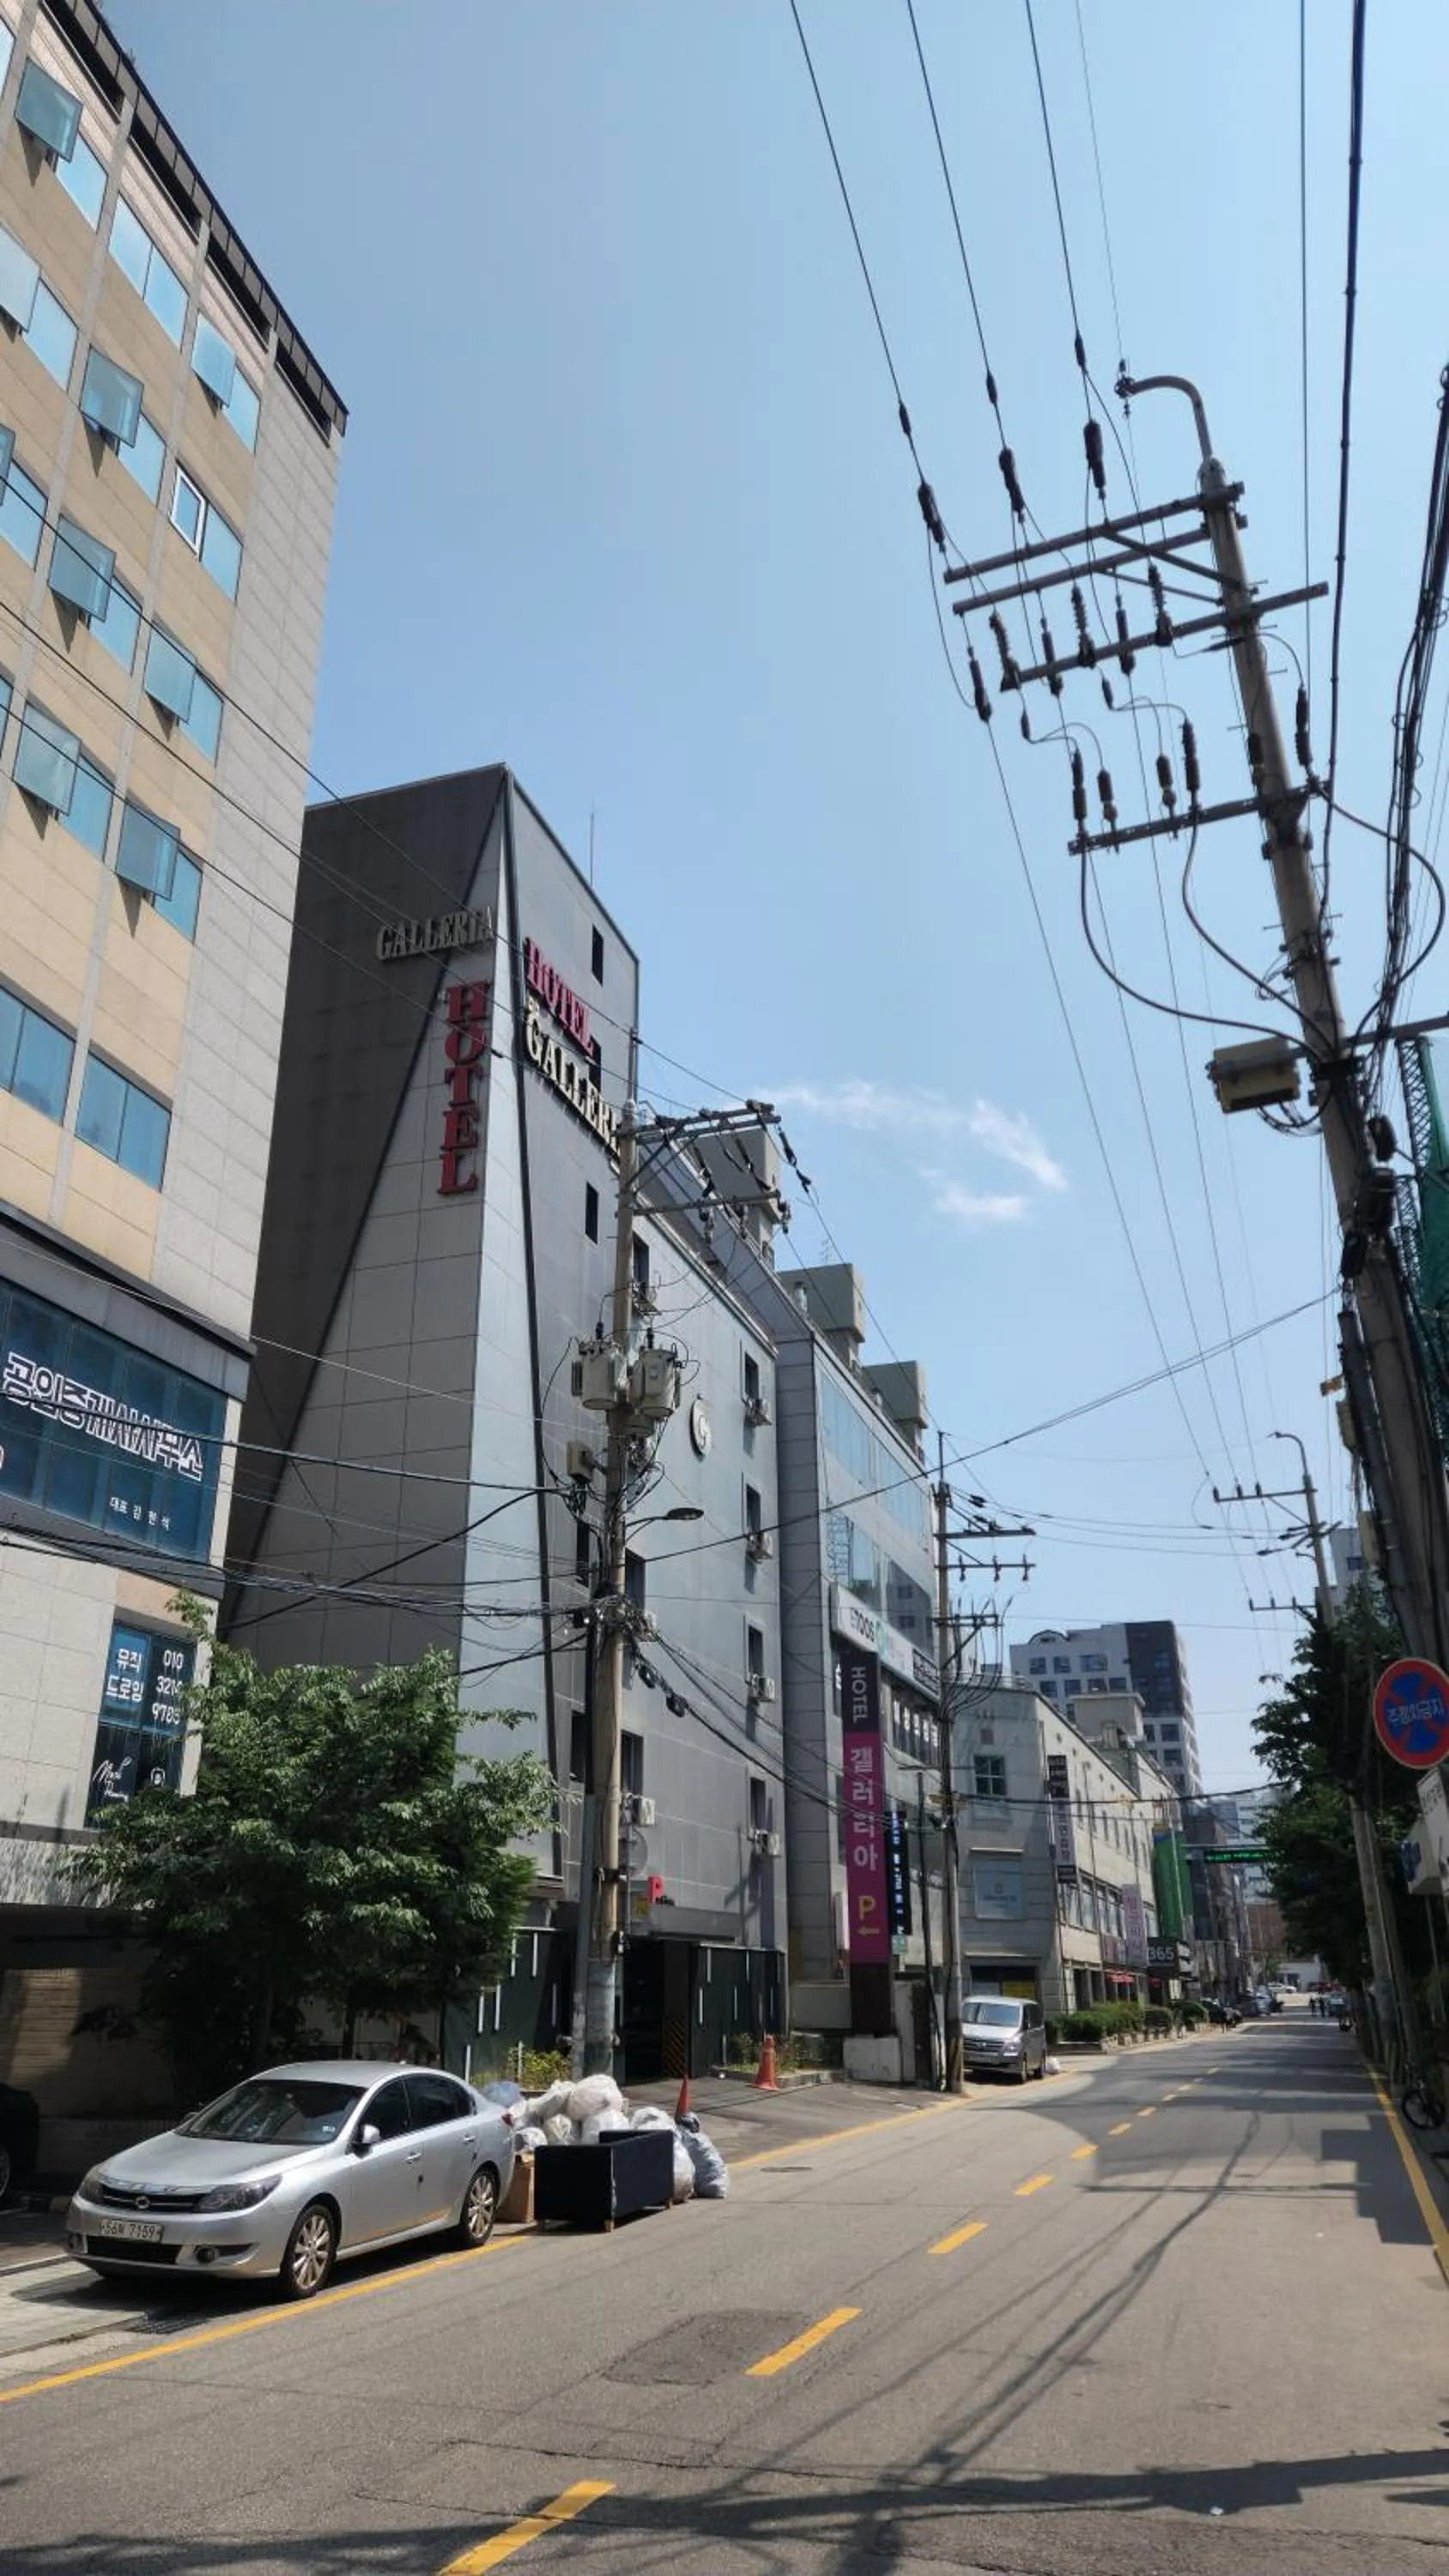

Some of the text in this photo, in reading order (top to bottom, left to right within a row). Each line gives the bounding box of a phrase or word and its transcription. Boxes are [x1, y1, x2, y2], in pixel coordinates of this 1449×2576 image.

[376, 906, 495, 962] GALLERIA
[524, 936, 598, 1060] HOTEL
[438, 979, 492, 1196] HOTEL
[525, 1015, 622, 1157] GALLERI
[117, 1648, 142, 1673] 뮤직
[163, 1649, 185, 1670] 010
[106, 1675, 143, 1703] 드로잉
[851, 1666, 869, 1724] HOTEL
[851, 1746, 878, 1872] 갤러리아
[859, 1895, 876, 1921] P
[1149, 1945, 1175, 1961] 365
